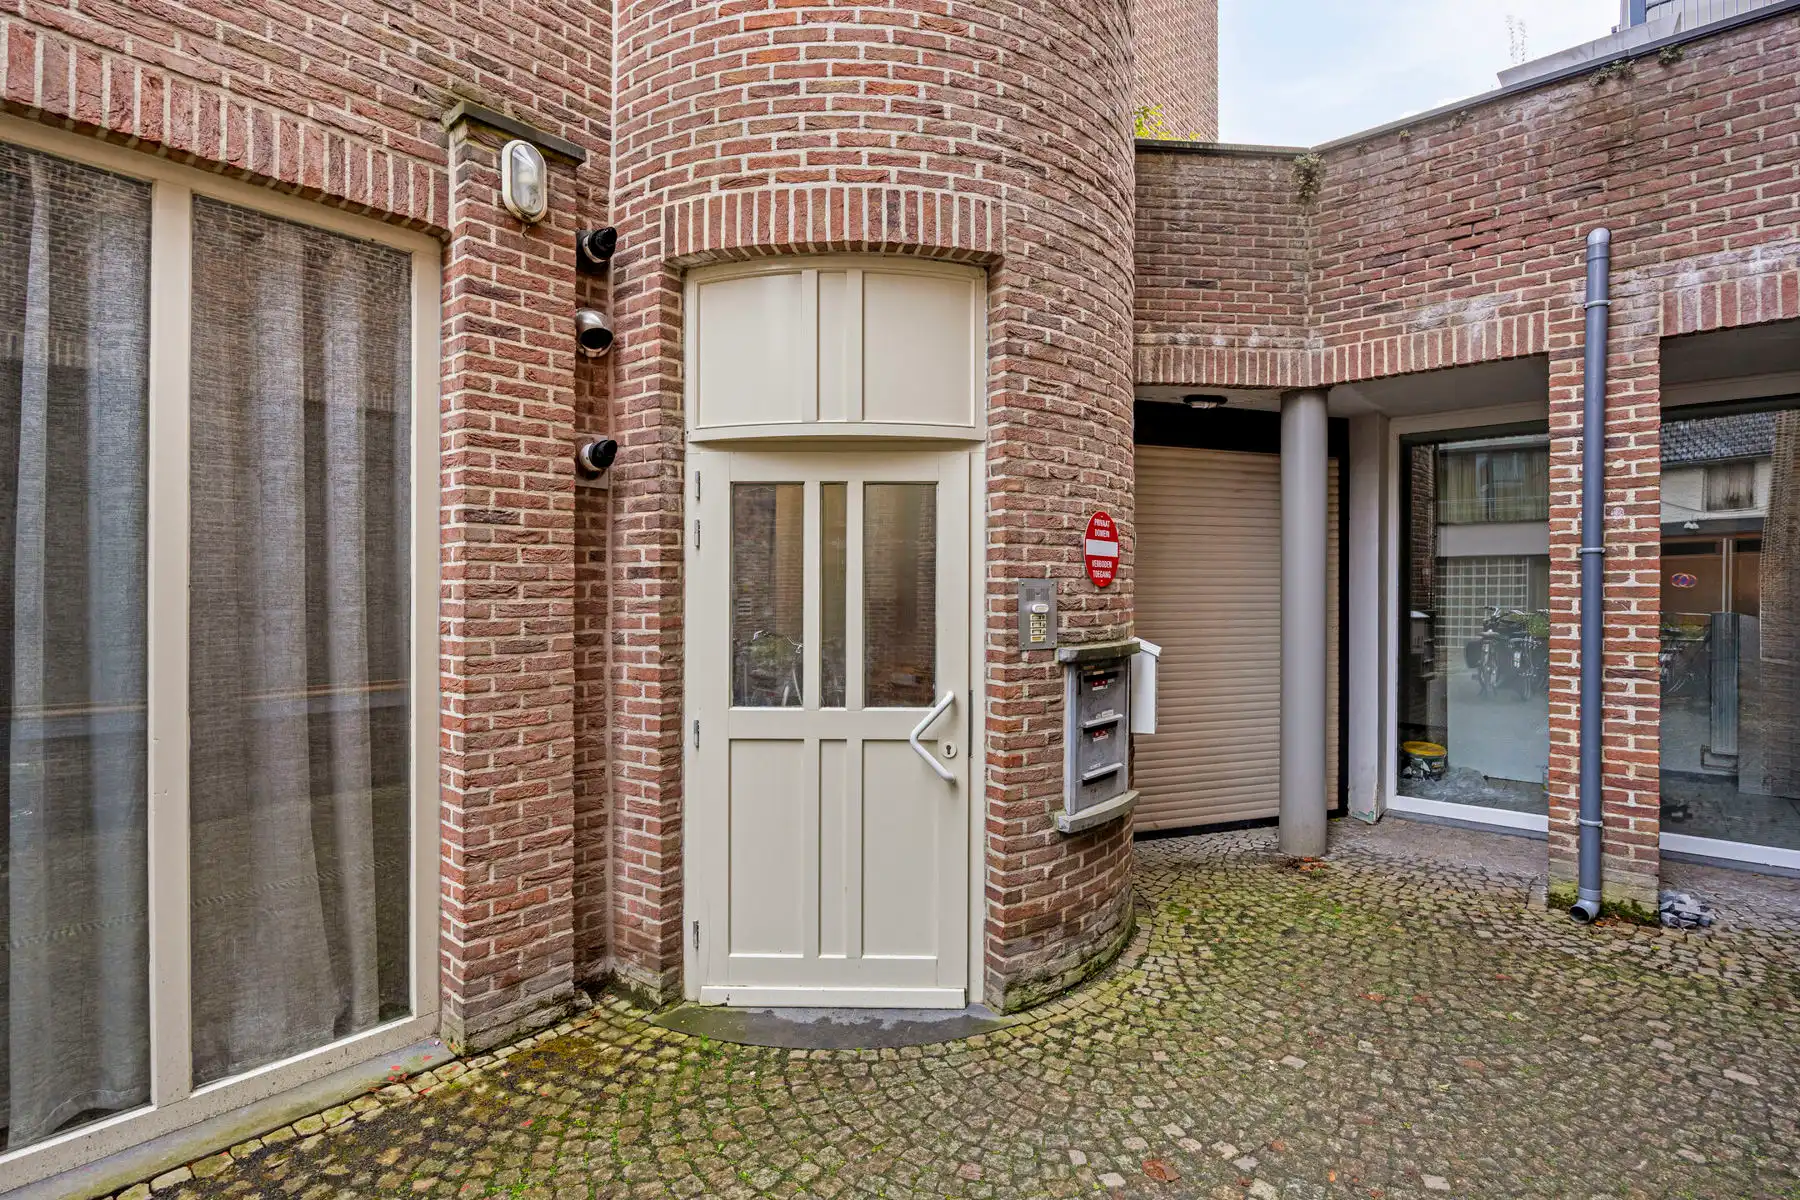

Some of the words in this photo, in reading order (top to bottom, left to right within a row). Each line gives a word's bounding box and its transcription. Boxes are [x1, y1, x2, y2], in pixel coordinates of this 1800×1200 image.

[1094, 518, 1111, 528] PRIVAAT
[1094, 529, 1110, 538] DOMEIN
[1091, 560, 1113, 568] VERBODEN
[1092, 570, 1112, 579] TOEGANG
